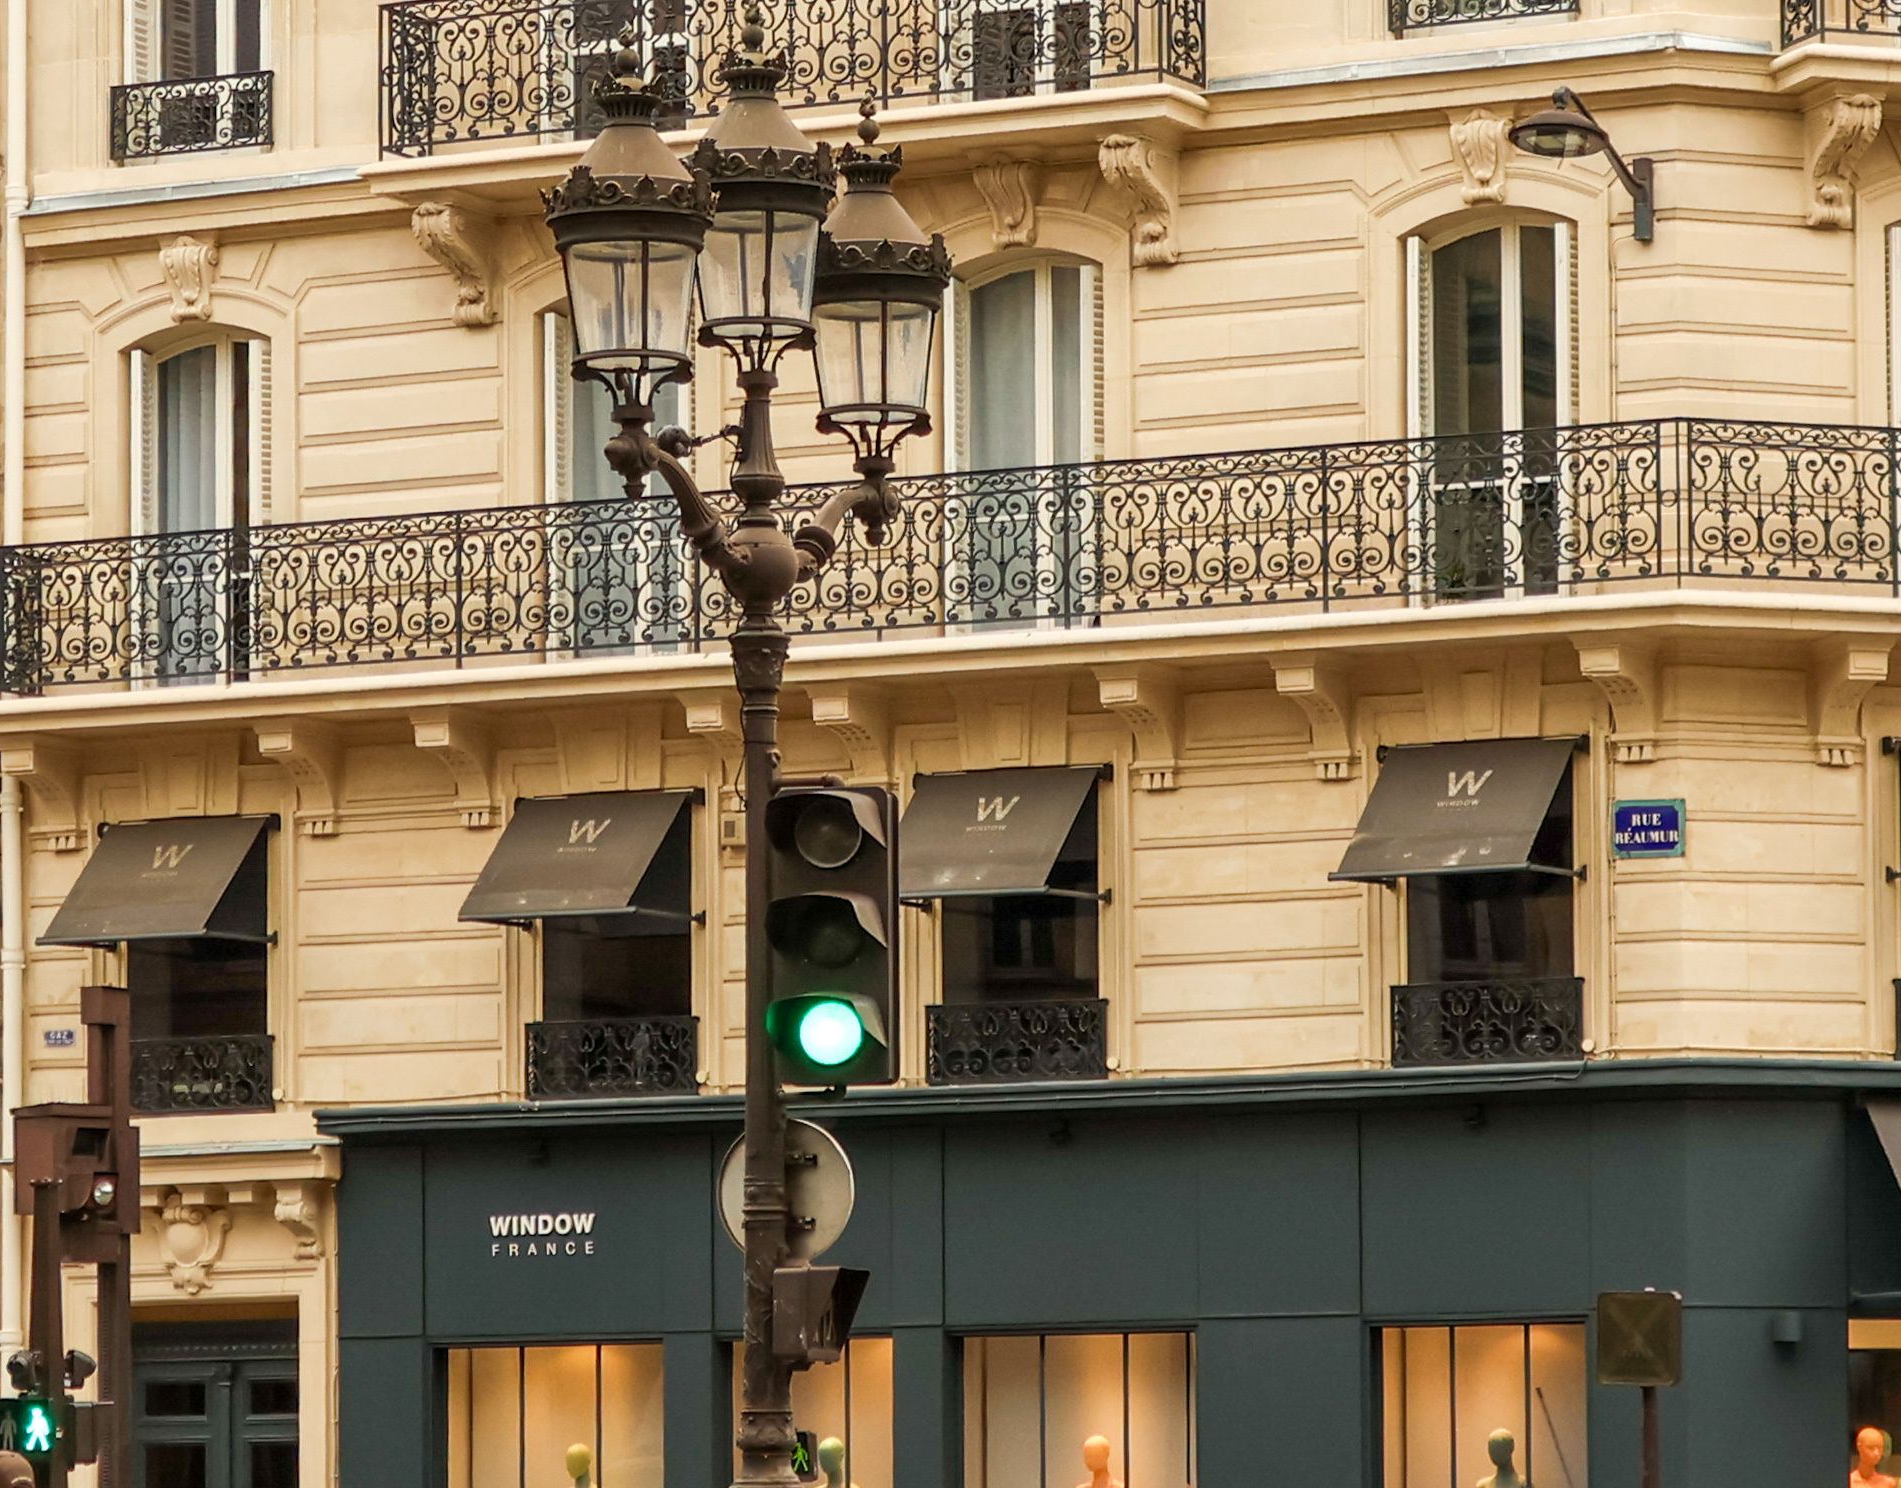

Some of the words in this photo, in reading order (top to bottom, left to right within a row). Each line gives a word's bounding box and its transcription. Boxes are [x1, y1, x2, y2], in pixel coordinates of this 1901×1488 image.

[1448, 769, 1493, 797] W
[977, 796, 1020, 822] W
[1631, 813, 1662, 827] RUE
[569, 818, 611, 844] W
[1615, 827, 1679, 844] RÉAUMUR
[152, 844, 194, 869] W
[489, 1213, 596, 1237] WINDOW
[491, 1241, 595, 1257] FRANCE
